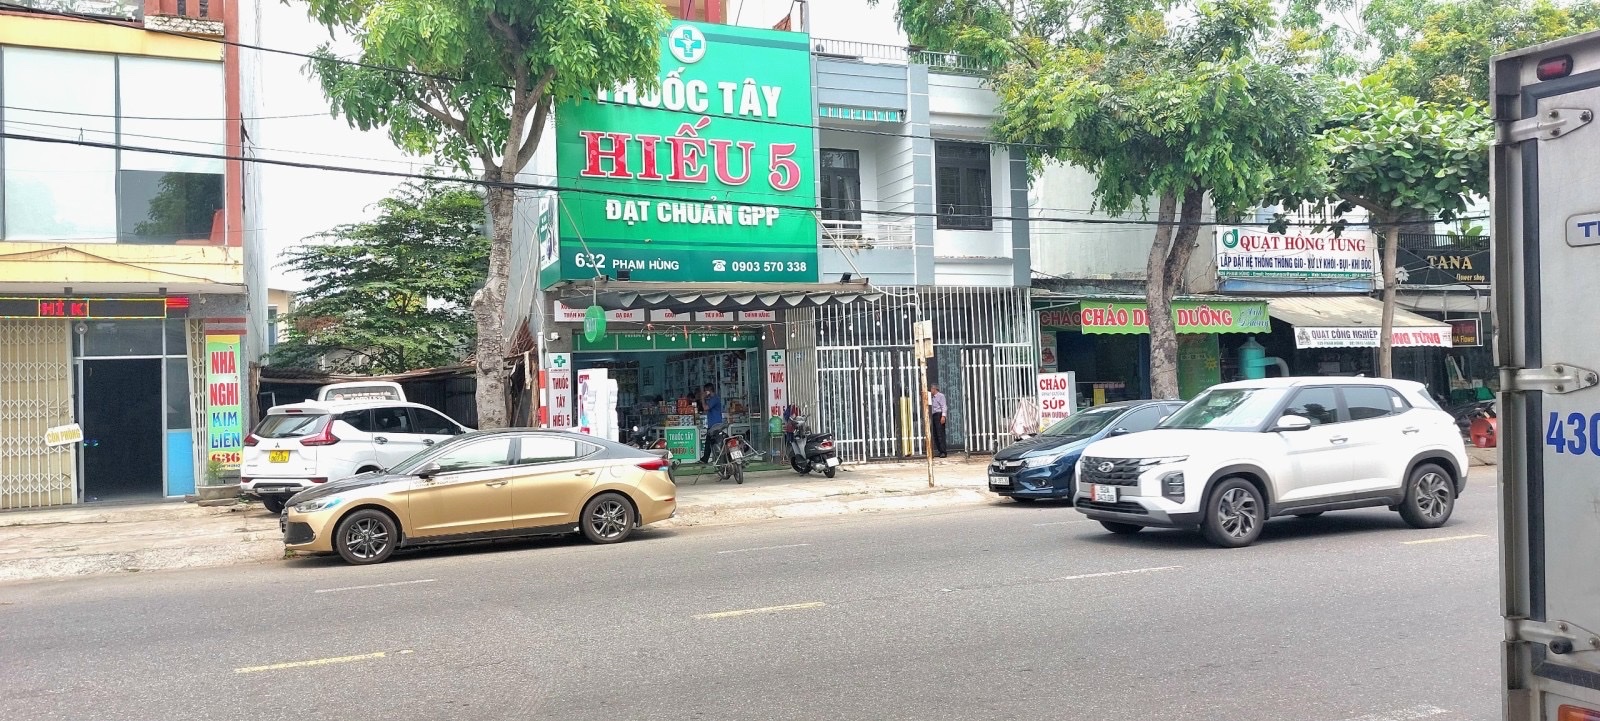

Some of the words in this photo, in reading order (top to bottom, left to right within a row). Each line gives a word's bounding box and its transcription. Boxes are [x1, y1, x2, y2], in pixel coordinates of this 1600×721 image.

[718, 78, 782, 118] TÂY
[579, 116, 755, 186] HIẾU
[768, 143, 801, 191] 5
[606, 199, 650, 226] ĐẠT
[738, 205, 780, 226] GPP
[1578, 221, 1600, 237] T
[1240, 235, 1280, 252] QUẠT
[1285, 230, 1325, 251] HỒNG
[575, 253, 606, 269] 632
[612, 259, 645, 272] PHẠM
[649, 257, 680, 271] HÙNG
[732, 261, 761, 272] 0903
[763, 261, 783, 272] 570
[787, 261, 807, 272] 338
[1233, 254, 1245, 269] ĐẶT
[1246, 254, 1253, 269] HỆ
[1254, 254, 1273, 268] THỐNG
[1274, 256, 1293, 269] THÔNG
[1427, 255, 1473, 270] TANA
[1473, 273, 1485, 283] shop
[1040, 307, 1081, 326] CHÁO
[1081, 304, 1128, 327] CHÁO
[1177, 303, 1233, 327] DƯỠNG
[1331, 328, 1351, 338] CÔNG
[1460, 335, 1475, 343] Flower
[211, 346, 236, 375] NHÀ
[552, 373, 569, 389] THUỐC
[770, 368, 784, 383] THUỐC
[1040, 375, 1067, 391] CHÁO
[210, 376, 239, 406] NGHỈ
[556, 394, 565, 408] TÂY
[1042, 396, 1065, 410] SÚP
[212, 411, 238, 428] KIM
[552, 410, 564, 427] HIẾU
[566, 414, 570, 426] 5
[211, 429, 241, 448] LIÊN
[669, 431, 684, 441] THUỐC
[211, 452, 241, 464] 636
